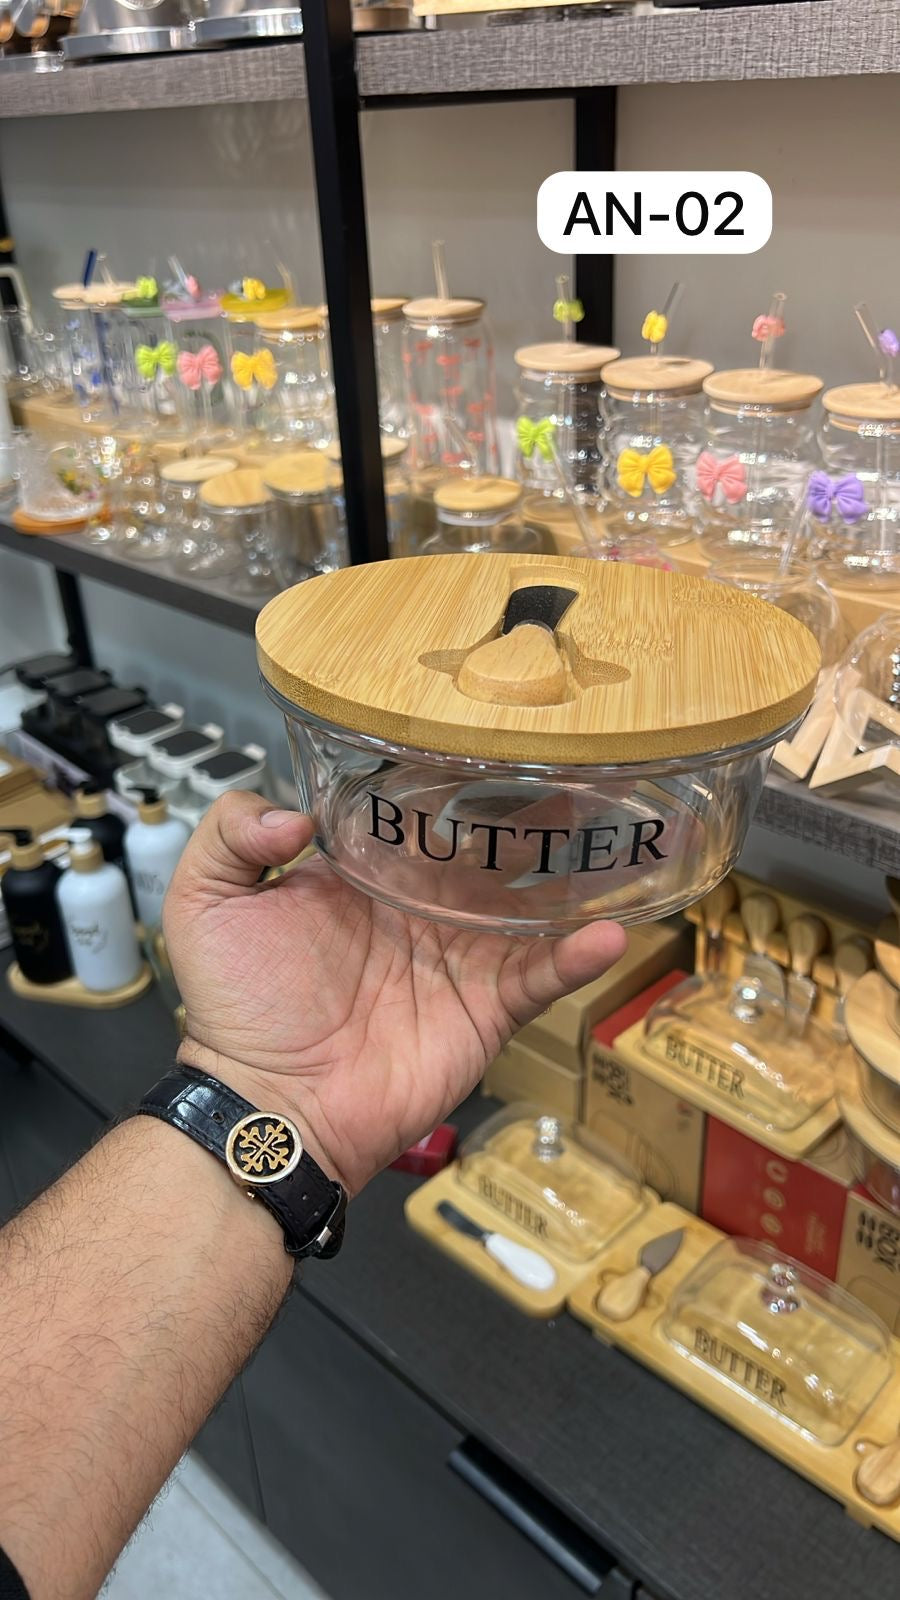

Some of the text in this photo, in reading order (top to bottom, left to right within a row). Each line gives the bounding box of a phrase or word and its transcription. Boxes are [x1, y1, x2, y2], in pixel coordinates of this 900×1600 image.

[366, 791, 669, 874] BUTTER
[665, 1033, 744, 1098] BUTTER
[694, 1327, 787, 1407] BUTTER
